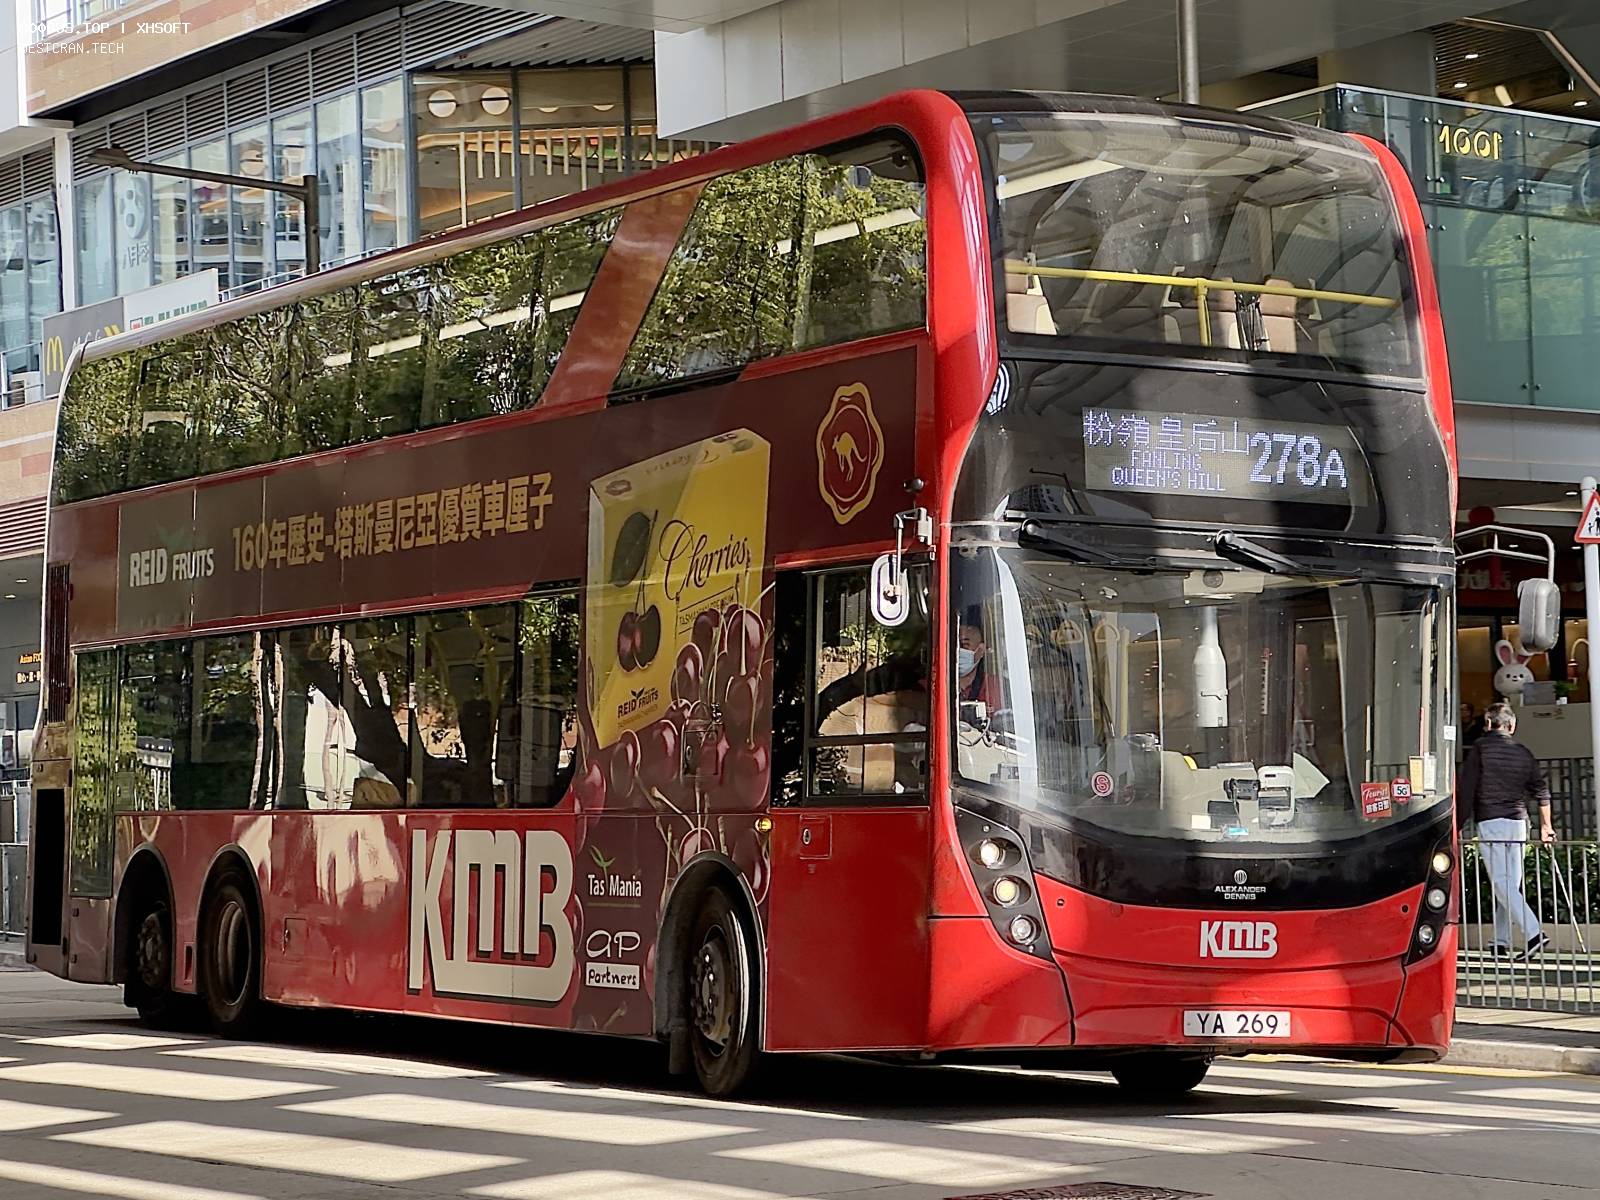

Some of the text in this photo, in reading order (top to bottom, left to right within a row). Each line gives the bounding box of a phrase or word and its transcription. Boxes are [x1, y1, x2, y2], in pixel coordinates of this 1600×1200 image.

[1082, 410, 1250, 455] 粉嶺皇后山
[1130, 449, 1202, 471] FANLING
[1249, 431, 1348, 489] 278A
[1111, 466, 1226, 492] QUEEN'S HILL
[129, 547, 215, 588] REID FRUITS
[658, 519, 748, 601] Cherries
[617, 698, 637, 719] REID
[1397, 785, 1408, 796] 5G
[588, 874, 642, 897] Tas Mania
[408, 829, 575, 1003] KMB
[1199, 920, 1278, 959] KMB
[1196, 1013, 1279, 1034] YA 269
